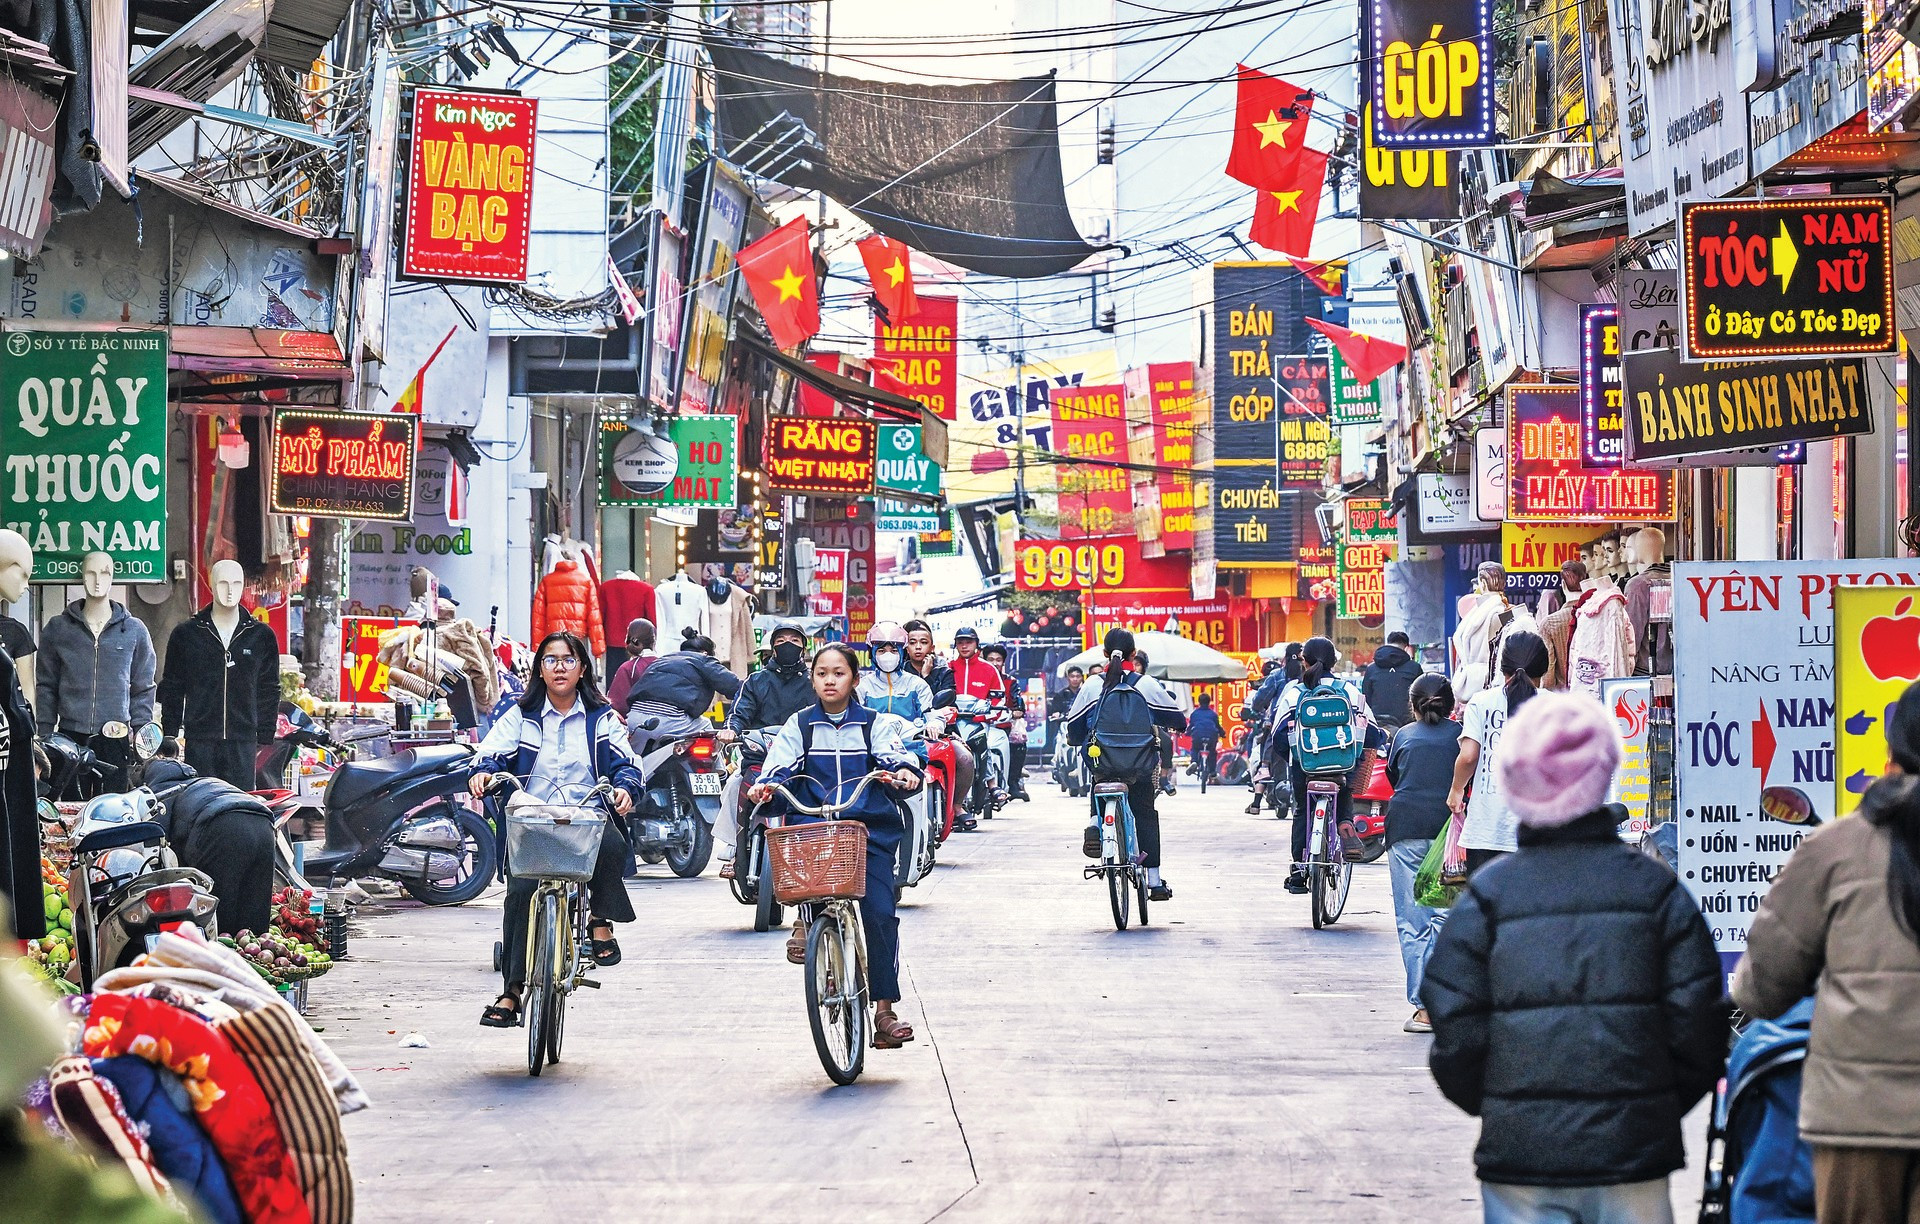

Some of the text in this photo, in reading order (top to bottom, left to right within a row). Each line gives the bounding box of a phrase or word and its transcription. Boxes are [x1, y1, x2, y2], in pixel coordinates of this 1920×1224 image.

[1383, 24, 1479, 119] GÓP
[435, 103, 517, 132] Kim Ngọc
[423, 131, 525, 193] VÀNG
[430, 192, 509, 252] BẠC
[1698, 212, 1880, 288] TÓC NAM
[1816, 248, 1870, 294] NỮ
[1630, 278, 1678, 310] Yên
[1229, 303, 1273, 338] BÁN
[1704, 303, 1881, 339] Ở Đây Có Tóc Đẹp
[34, 333, 160, 350] SỞ Y TẾ BẮC NINH
[1229, 340, 1271, 378] TRẢ
[1282, 358, 1327, 379] CẦM
[18, 353, 148, 437] QUẦY
[1229, 387, 1274, 421] GÓP
[1291, 381, 1320, 400] ĐỒ
[1343, 383, 1372, 401] ĐIỆN
[1637, 360, 1859, 444] BÁNH SINH NHẬT
[1340, 402, 1378, 419] THOẠI
[783, 420, 862, 452] RĂNG
[997, 424, 1018, 443] &
[1280, 417, 1303, 441] NHÀ
[1521, 415, 1580, 467] ĐIỆN
[281, 419, 405, 479] MỸ PHẨM
[1284, 442, 1328, 460] 6886
[1599, 438, 1623, 453] CH
[6, 431, 160, 503] THUỐC
[773, 457, 869, 482] VIỆT NHẬT
[877, 453, 930, 483] QUẦY
[674, 466, 722, 501] MẮT
[1220, 480, 1279, 509] CHUYỂN
[1527, 469, 1587, 510] MÁY
[1591, 469, 1656, 510] TÍNH
[296, 497, 385, 511] ĐT: 0974.374.633
[80, 520, 161, 552] NAM
[877, 520, 937, 531] 0963.094.381
[1234, 515, 1268, 543] TIỀN
[1351, 510, 1377, 534] TẠP
[392, 526, 473, 556] Food
[1510, 534, 1580, 568] LẤY NG
[47, 561, 153, 575] 0969.100
[815, 553, 840, 575] ẬN
[1023, 545, 1124, 588] 9999
[1345, 543, 1383, 569] CHÈ
[1342, 569, 1385, 593] THÁI
[1507, 575, 1525, 588] ĐT:
[1346, 592, 1383, 615] LAN
[1686, 569, 1784, 623] YÊN
[350, 654, 390, 693] VA
[1711, 658, 1835, 683] NÂNG TẦM
[1776, 698, 1835, 728] NAM
[1686, 711, 1740, 767] TÓC
[1791, 741, 1835, 783] NỮ
[1700, 805, 1741, 823] NAIL
[1701, 829, 1738, 853] UỐN
[1755, 830, 1810, 852] NHUÔ
[1701, 861, 1771, 883] CHUYÊN
[1701, 889, 1765, 913] NỐI TÓ
[1728, 927, 1747, 944] TẠ
